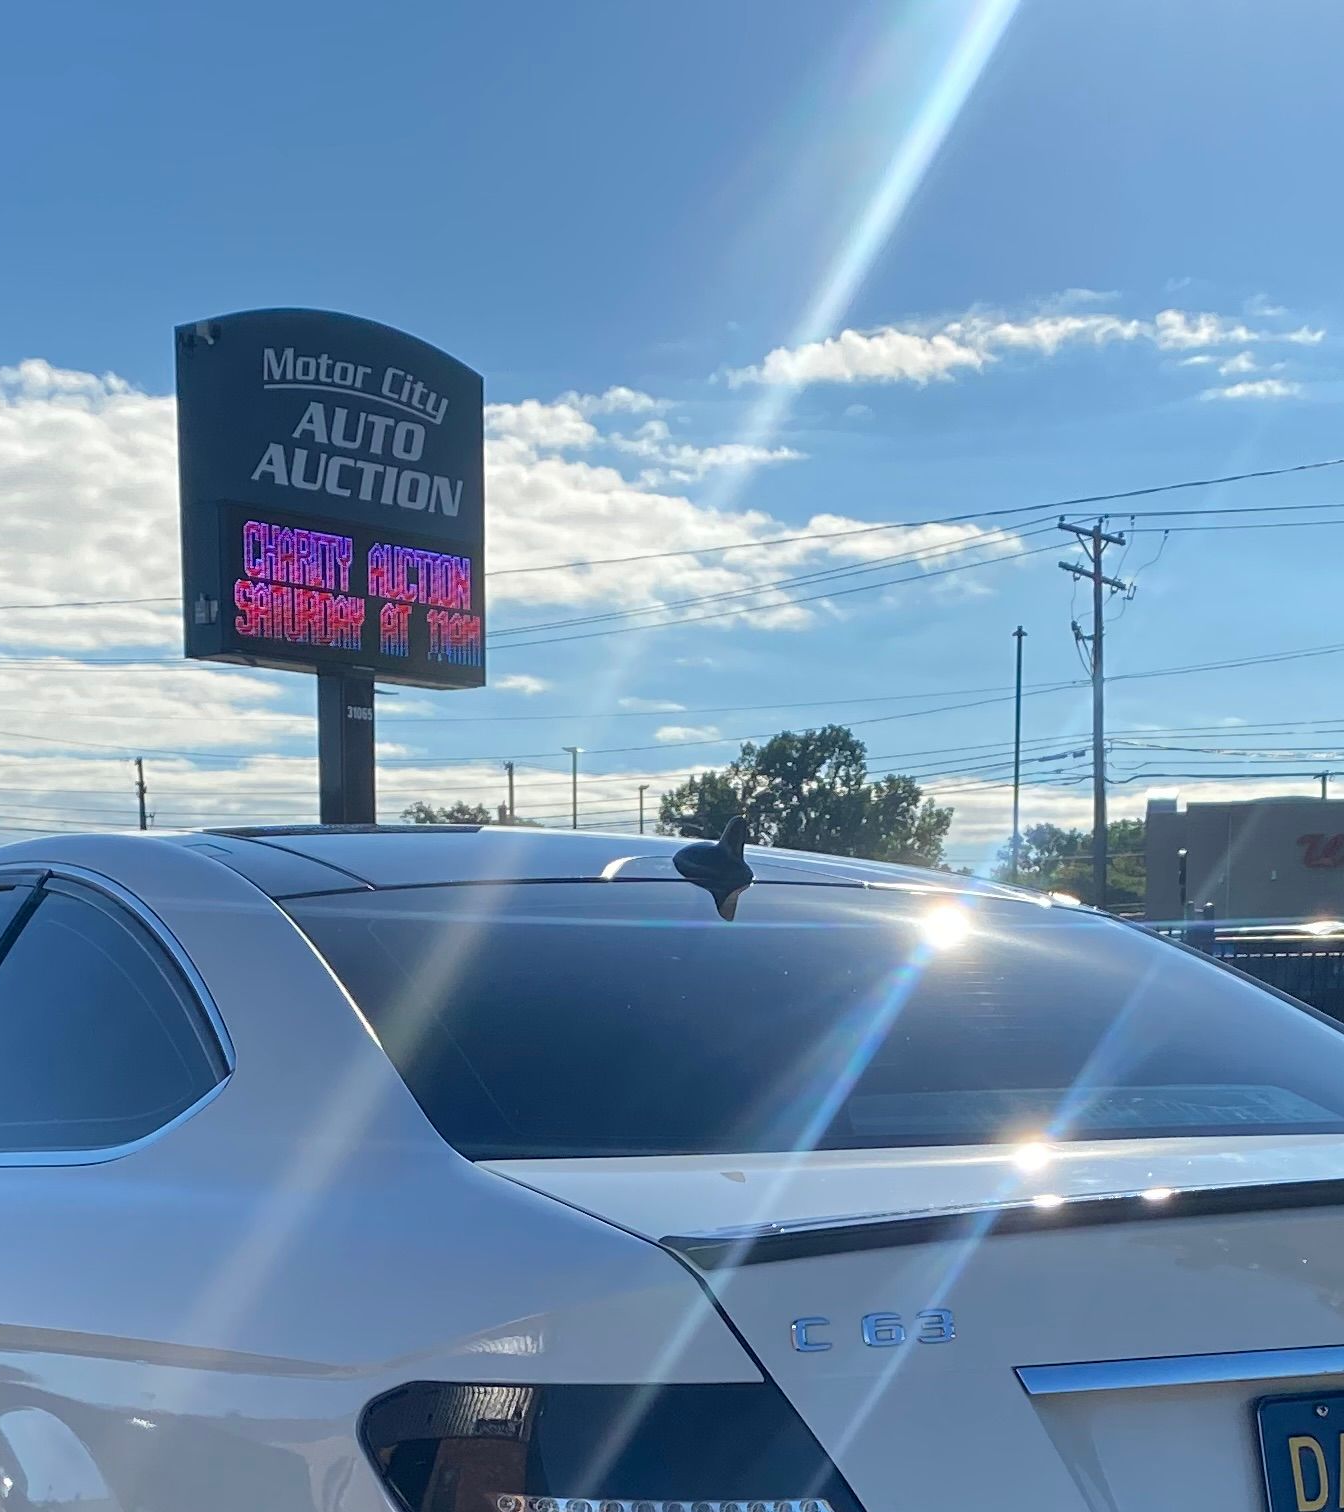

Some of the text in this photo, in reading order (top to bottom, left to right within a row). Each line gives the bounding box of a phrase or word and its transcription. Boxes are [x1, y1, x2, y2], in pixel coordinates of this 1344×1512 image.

[263, 346, 449, 423] Motor City
[292, 401, 426, 461] AUTO
[251, 443, 463, 517] AUCTION
[243, 520, 471, 610] CHARITY AUCTION
[234, 579, 365, 651] SATURDAY
[379, 603, 413, 657] AT
[791, 1308, 956, 1353] C 63
